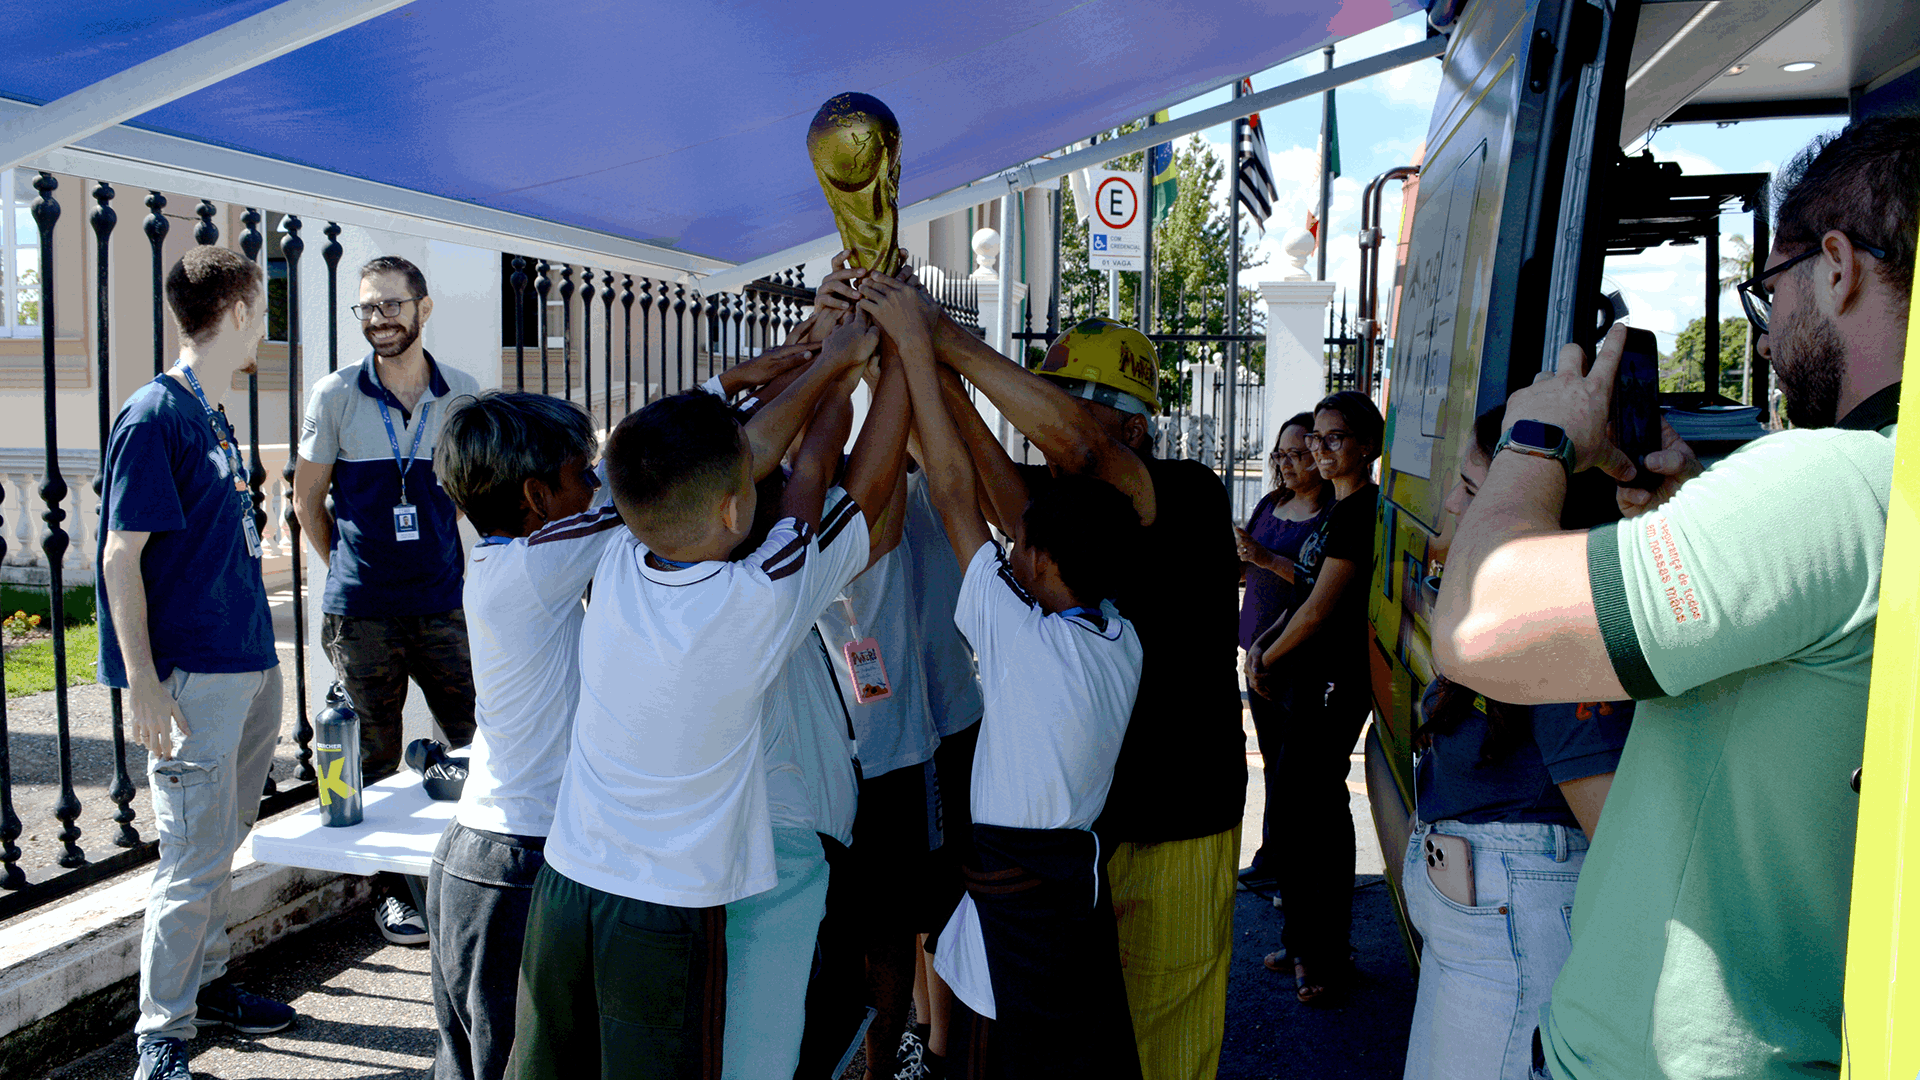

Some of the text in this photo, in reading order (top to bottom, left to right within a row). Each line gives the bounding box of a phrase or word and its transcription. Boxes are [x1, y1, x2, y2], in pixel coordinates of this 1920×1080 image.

[1110, 189, 1123, 216] E
[1646, 524, 1687, 623] em nossas mãos
[1661, 524, 1683, 571] segurança
[1677, 573, 1689, 586] de
[1684, 588, 1701, 620] todos
[318, 756, 357, 807] K
